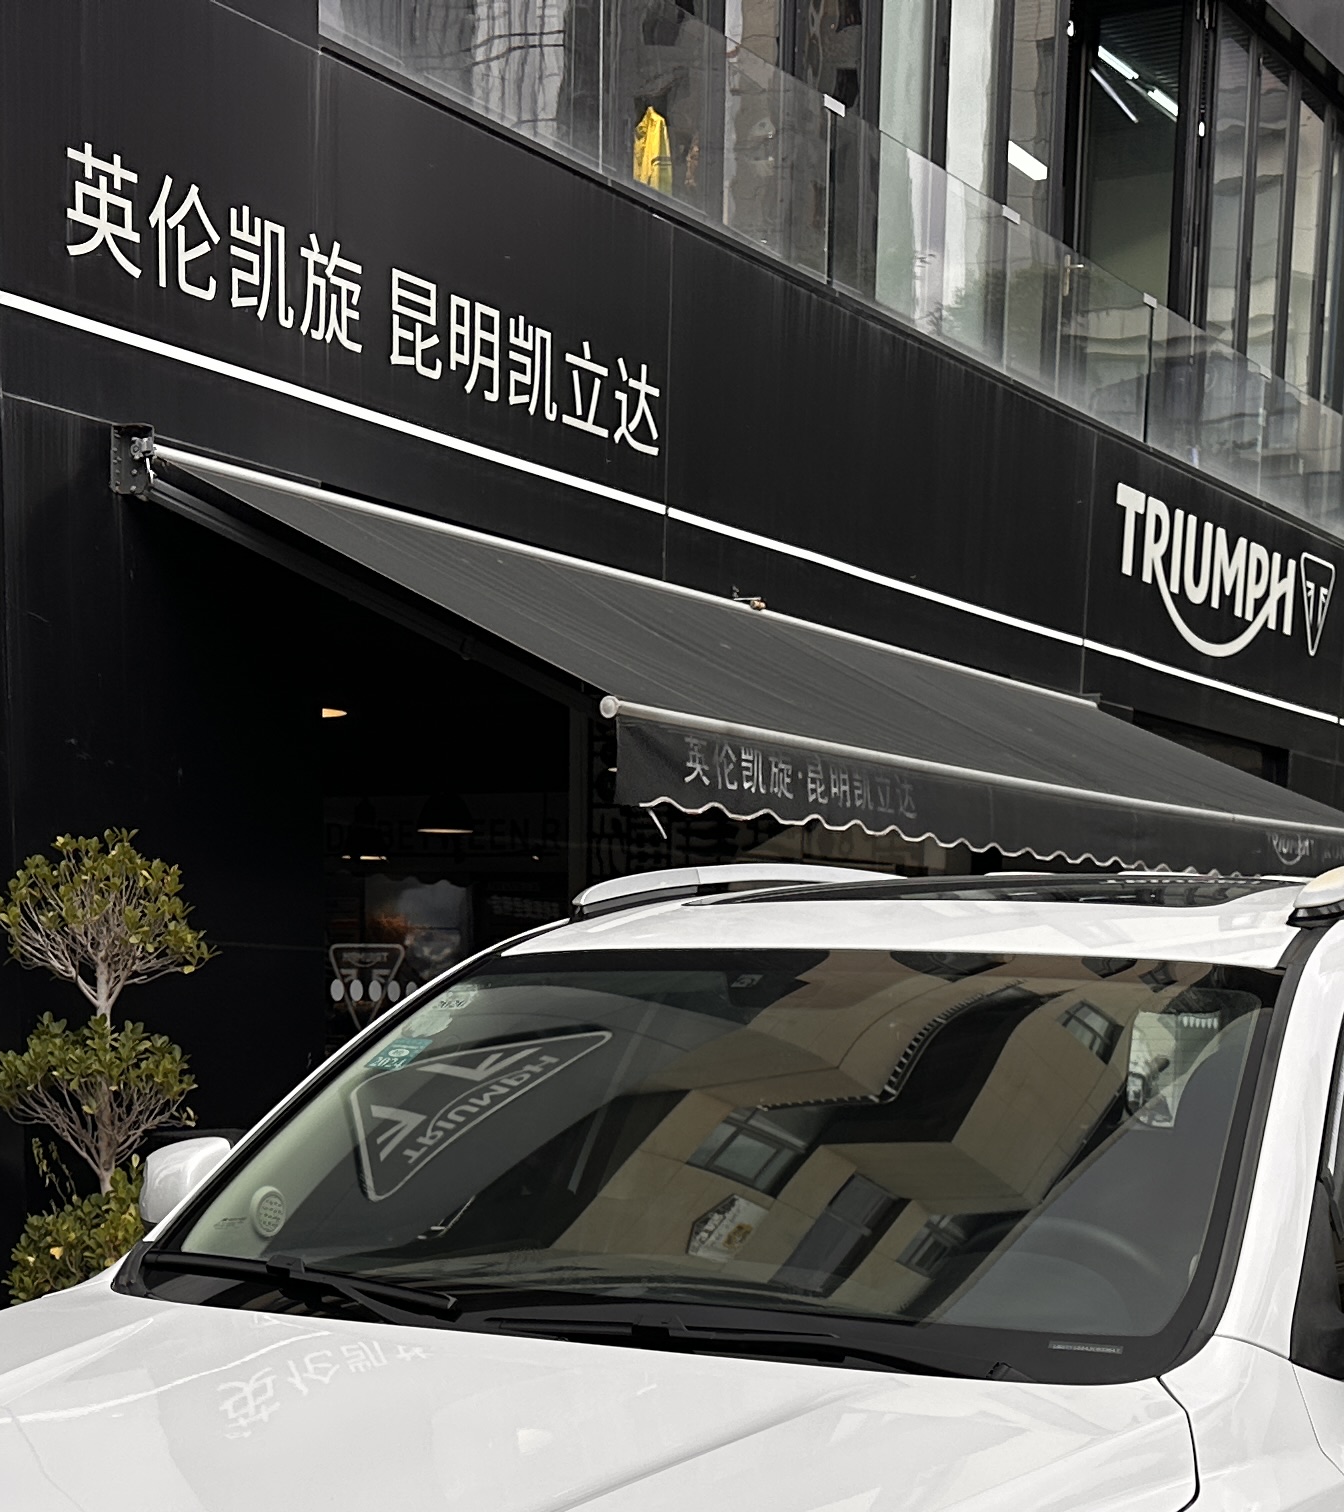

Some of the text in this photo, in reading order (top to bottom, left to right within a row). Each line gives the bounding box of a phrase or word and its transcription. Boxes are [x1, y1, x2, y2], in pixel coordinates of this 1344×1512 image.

[66, 141, 660, 456] 英伦凯旋 昆明凯立达
[1116, 482, 1297, 658] TRIUMPH
